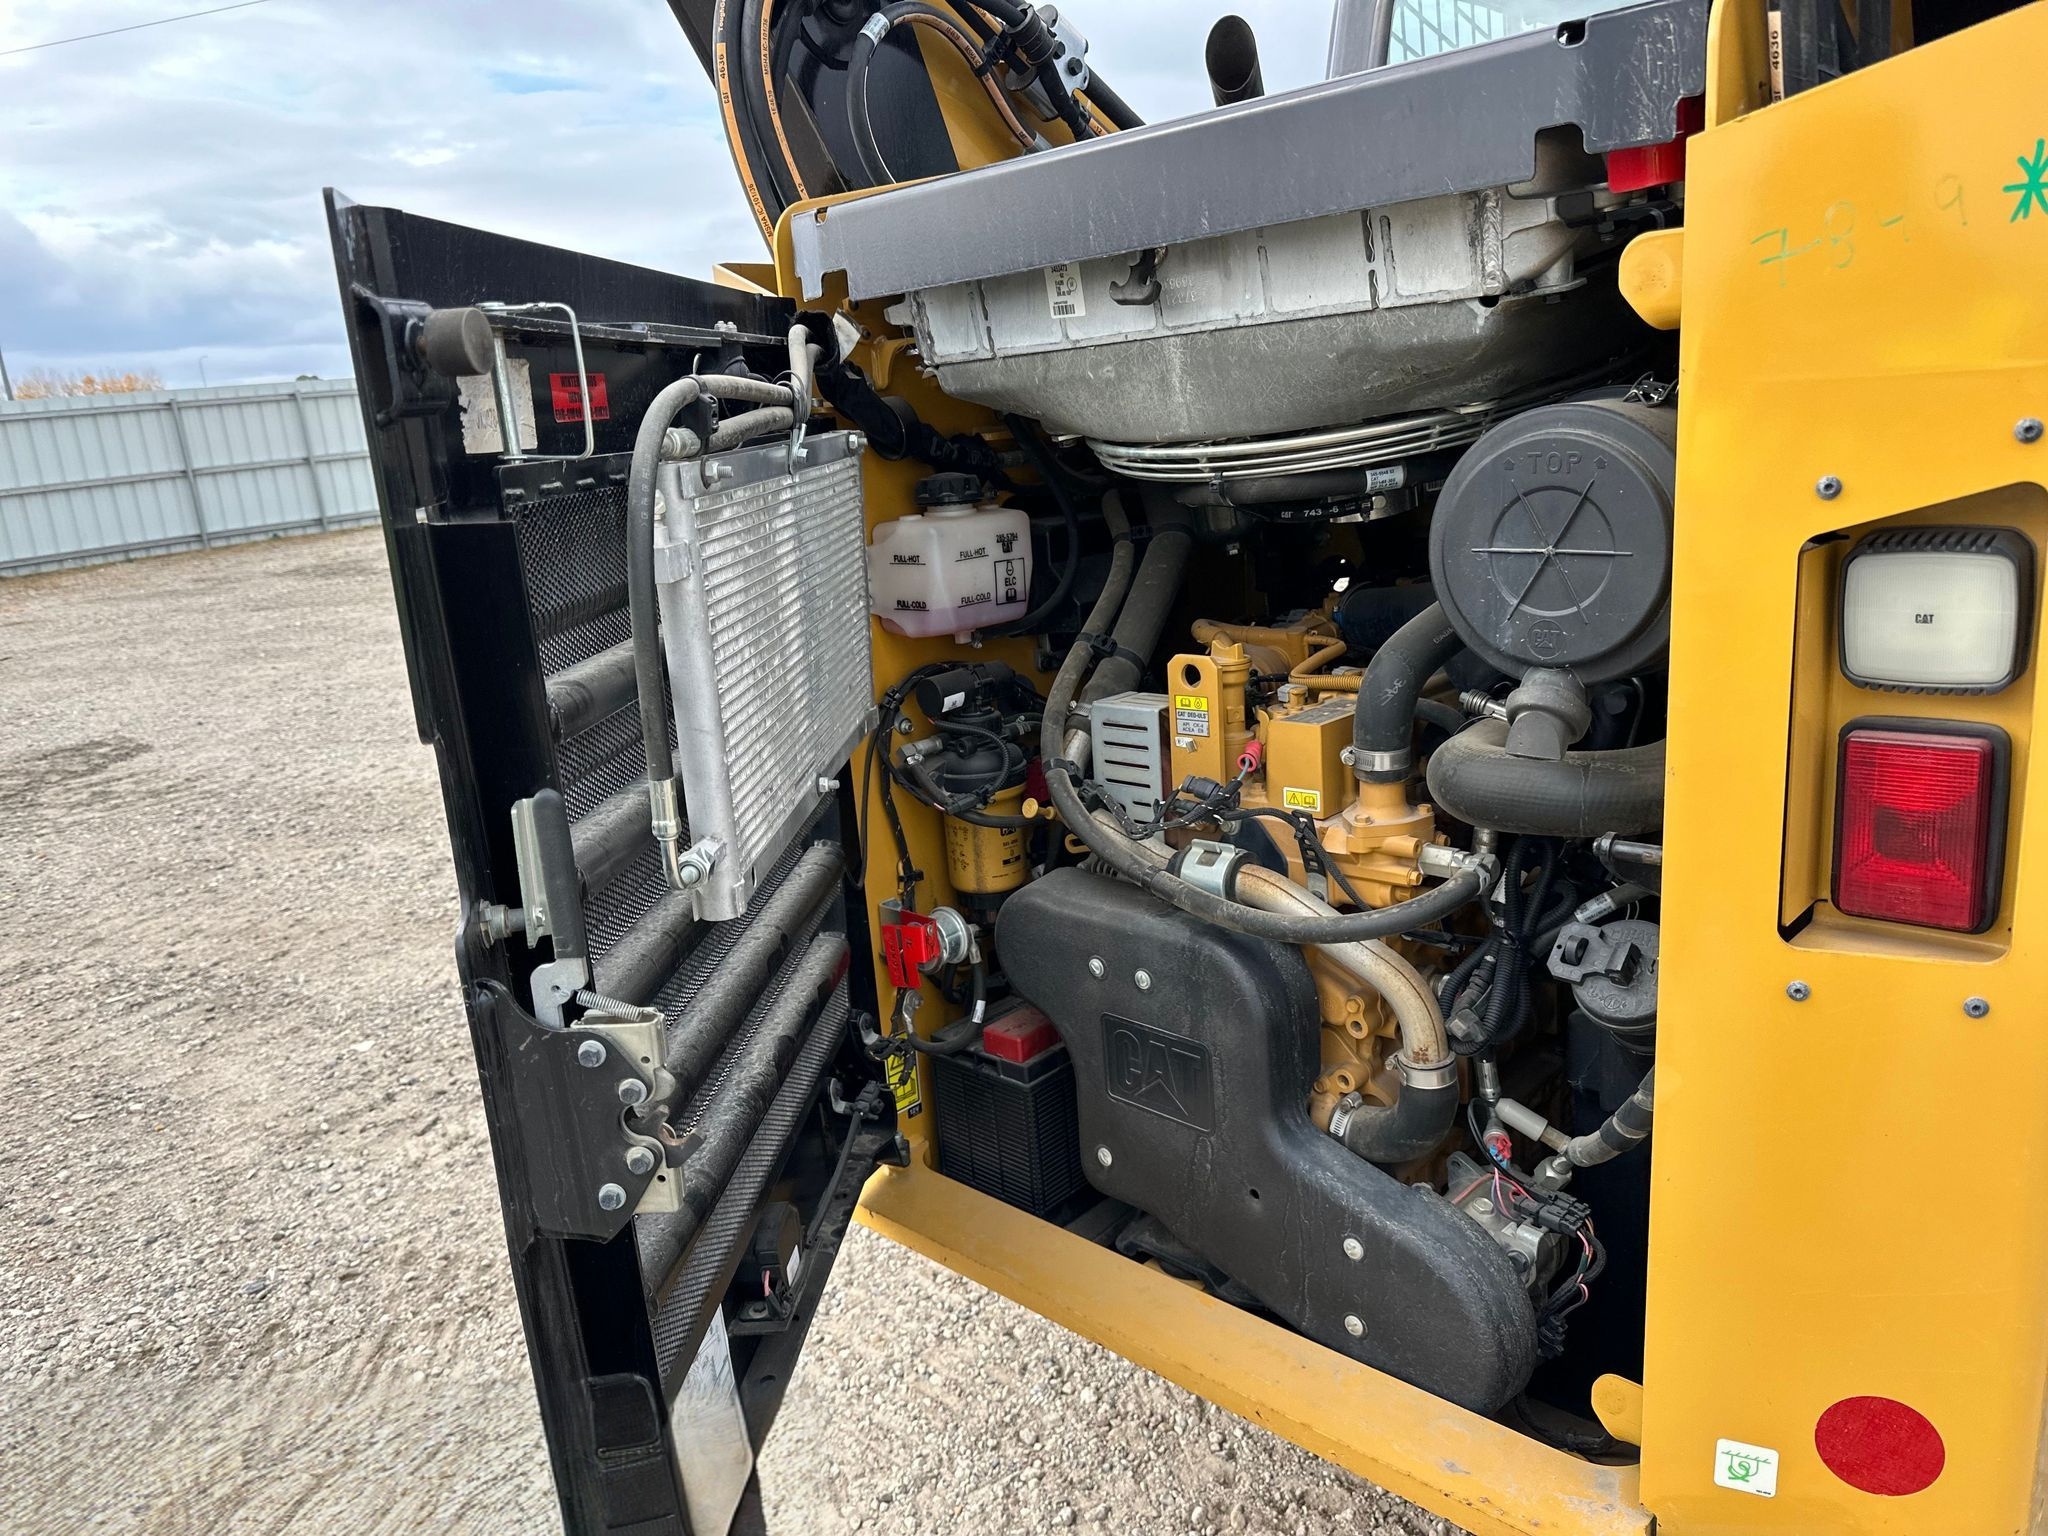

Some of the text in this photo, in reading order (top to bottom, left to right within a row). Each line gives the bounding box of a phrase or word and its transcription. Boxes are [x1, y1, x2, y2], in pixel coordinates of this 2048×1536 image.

[1771, 30, 1780, 70] 4636
[718, 54, 726, 79] 4636
[760, 216, 774, 238] MSHA
[1527, 451, 1583, 475] TOP
[1303, 508, 1322, 518] 743
[893, 555, 920, 563] FULL-HOT
[959, 547, 986, 559] FULL-HOT
[1004, 576, 1017, 587] ELC
[896, 599, 927, 609] FULL-COLD
[960, 592, 991, 605] FULL-COLD
[1915, 613, 1935, 624] CAT
[1532, 628, 1560, 649] CAT
[1112, 1029, 1202, 1116] CAT
